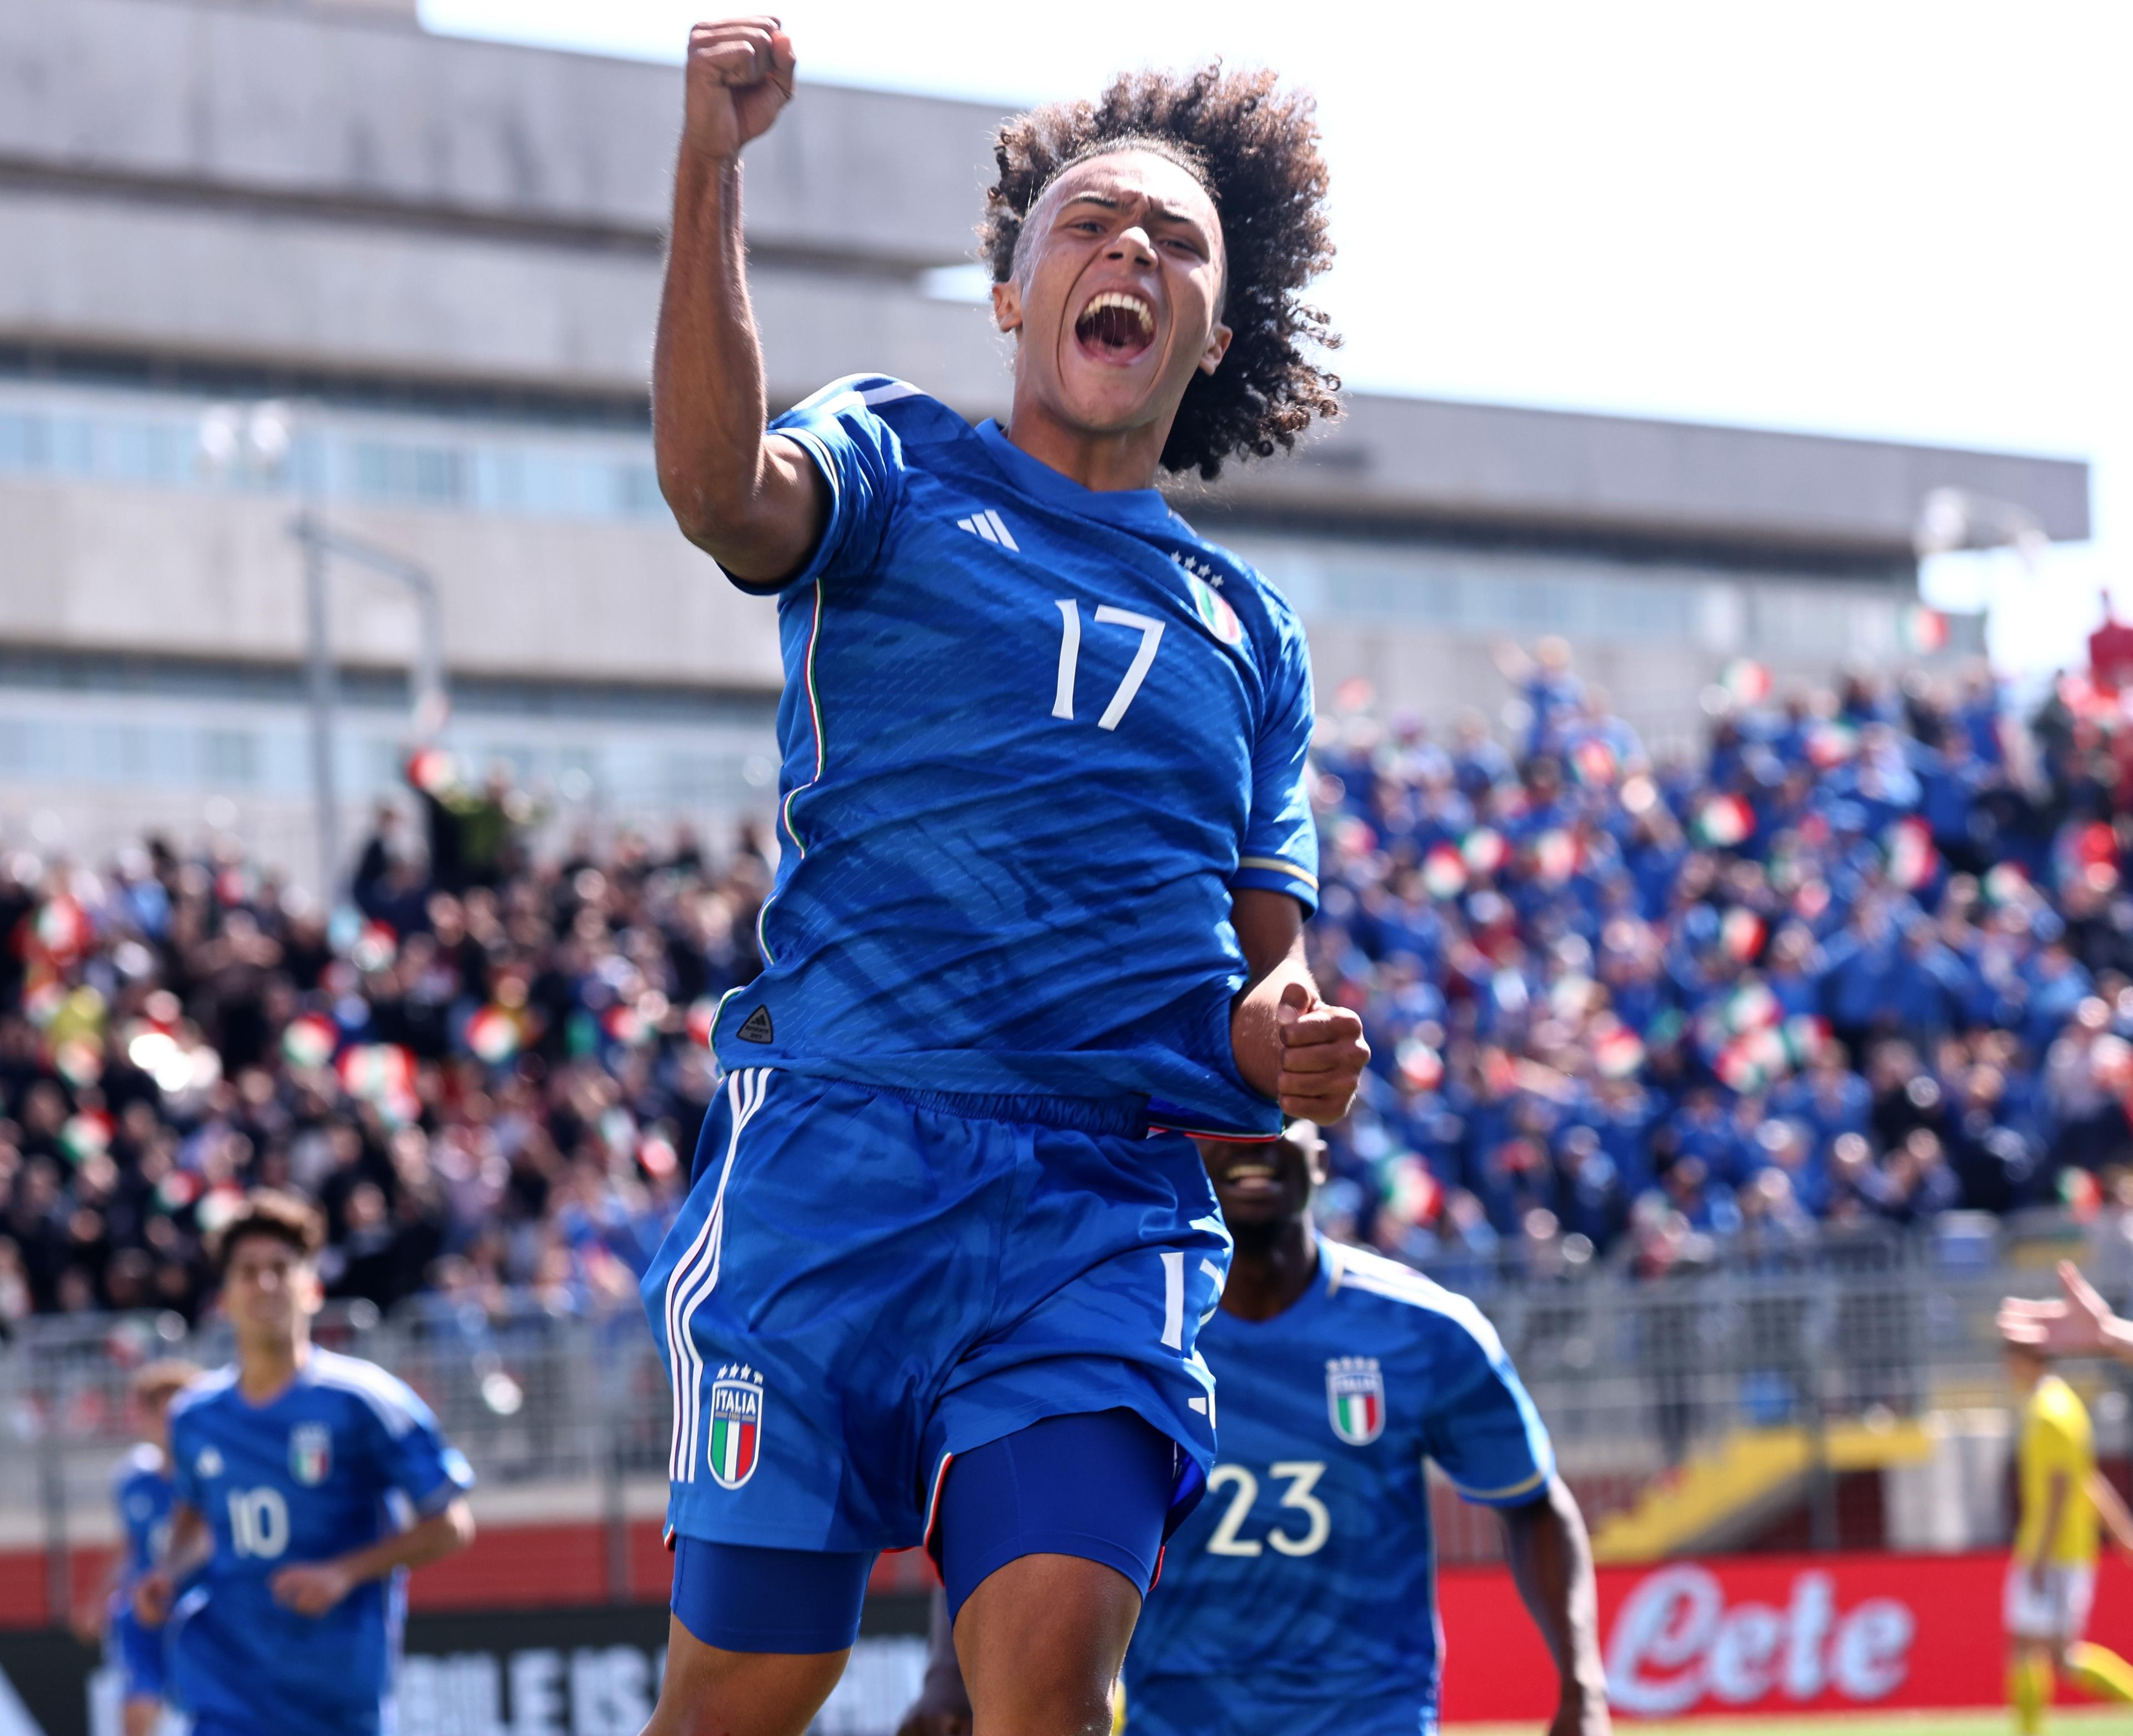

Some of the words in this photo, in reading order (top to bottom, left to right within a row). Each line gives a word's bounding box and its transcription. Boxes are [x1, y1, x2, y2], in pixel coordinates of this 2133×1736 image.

[1052, 598, 1166, 731] 17
[715, 1389, 756, 1415] ITALIA
[227, 1486, 290, 1559] 10
[1208, 1461, 1331, 1557] 23
